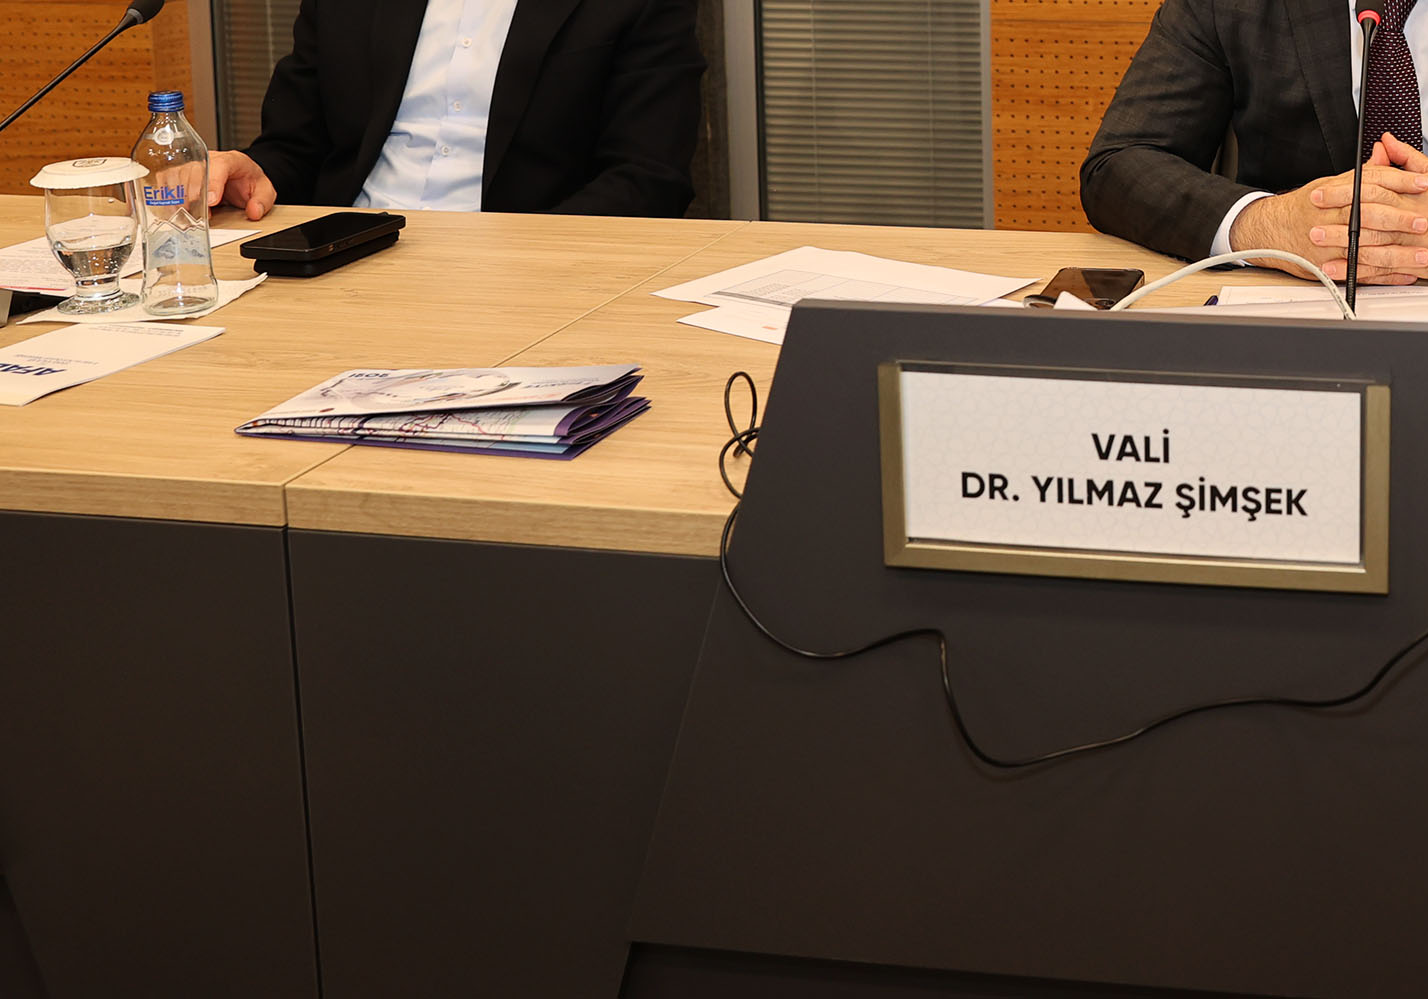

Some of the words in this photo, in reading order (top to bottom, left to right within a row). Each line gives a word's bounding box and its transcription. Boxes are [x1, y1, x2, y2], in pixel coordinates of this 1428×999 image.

[143, 185, 185, 200] Erikli
[1092, 428, 1171, 463] VALİ
[961, 472, 1019, 502] DR.
[1031, 476, 1163, 510] YILMAZ
[1175, 476, 1308, 522] ŞİMŞEK
